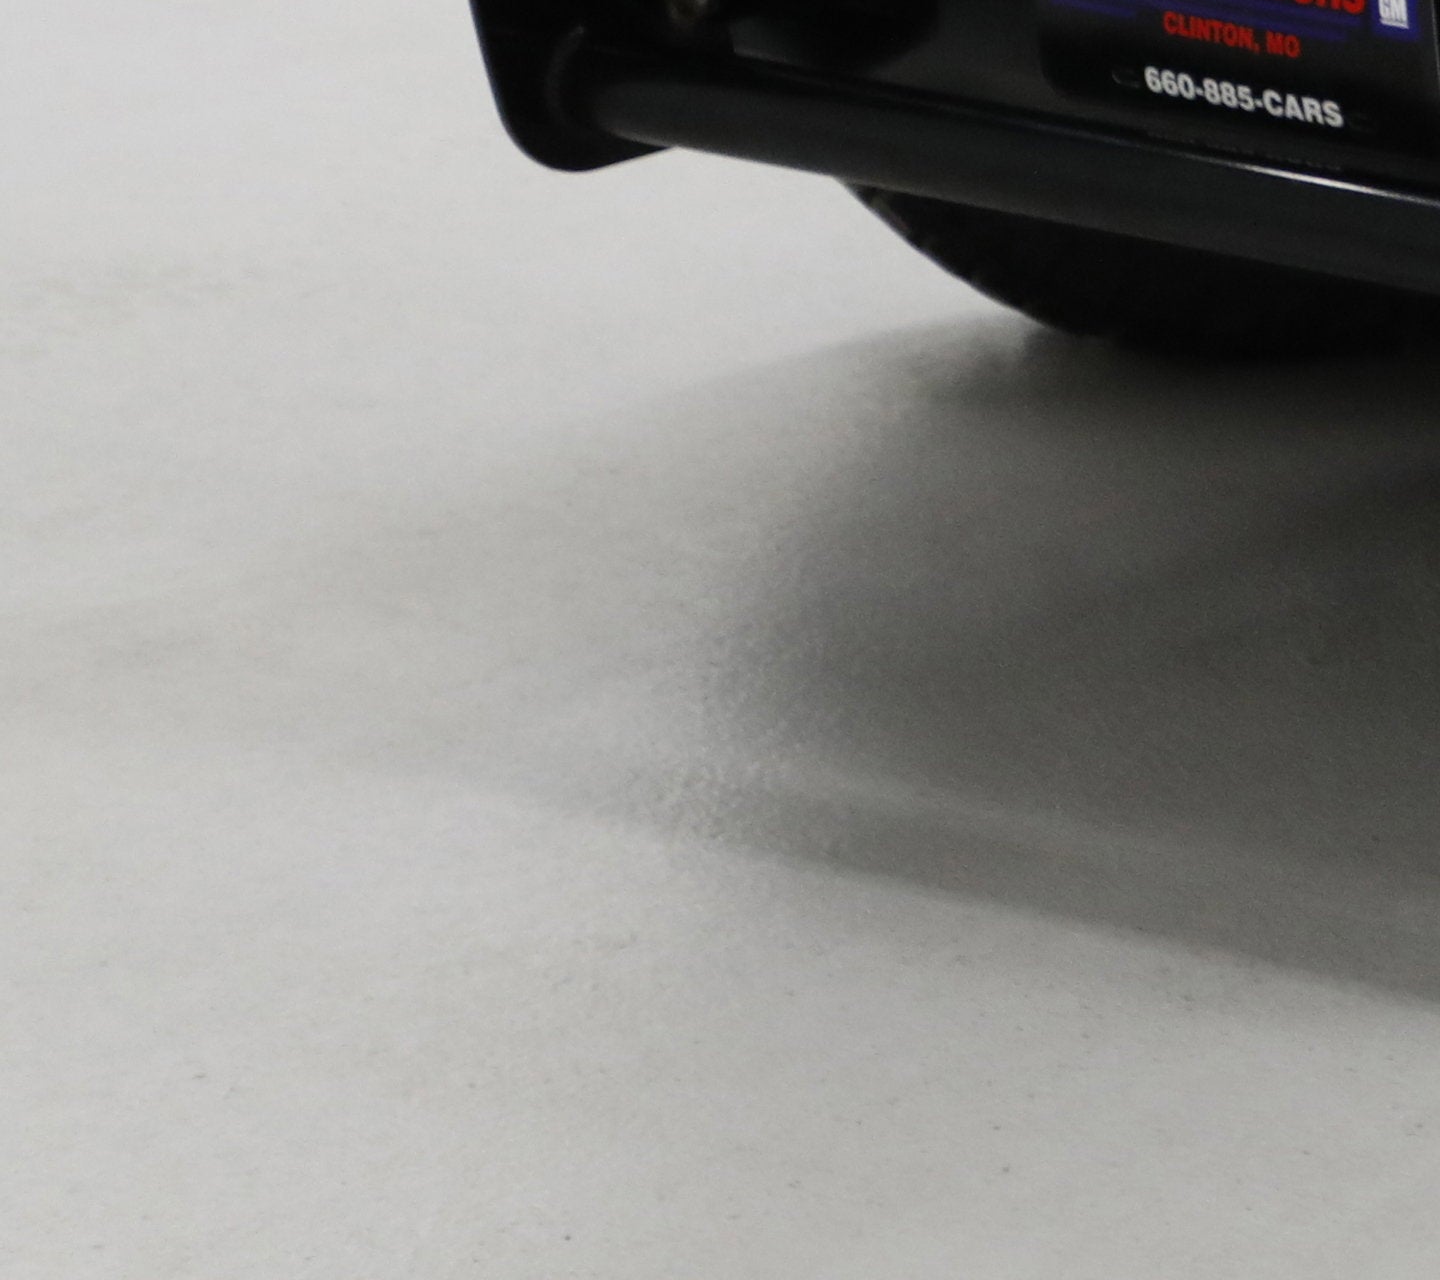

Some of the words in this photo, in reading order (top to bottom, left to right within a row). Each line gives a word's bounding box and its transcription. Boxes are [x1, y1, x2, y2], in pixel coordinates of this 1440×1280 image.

[1162, 10, 1260, 55] CLINTON,
[1266, 31, 1301, 58] MO
[1143, 65, 1345, 128] 660-885-CARS
